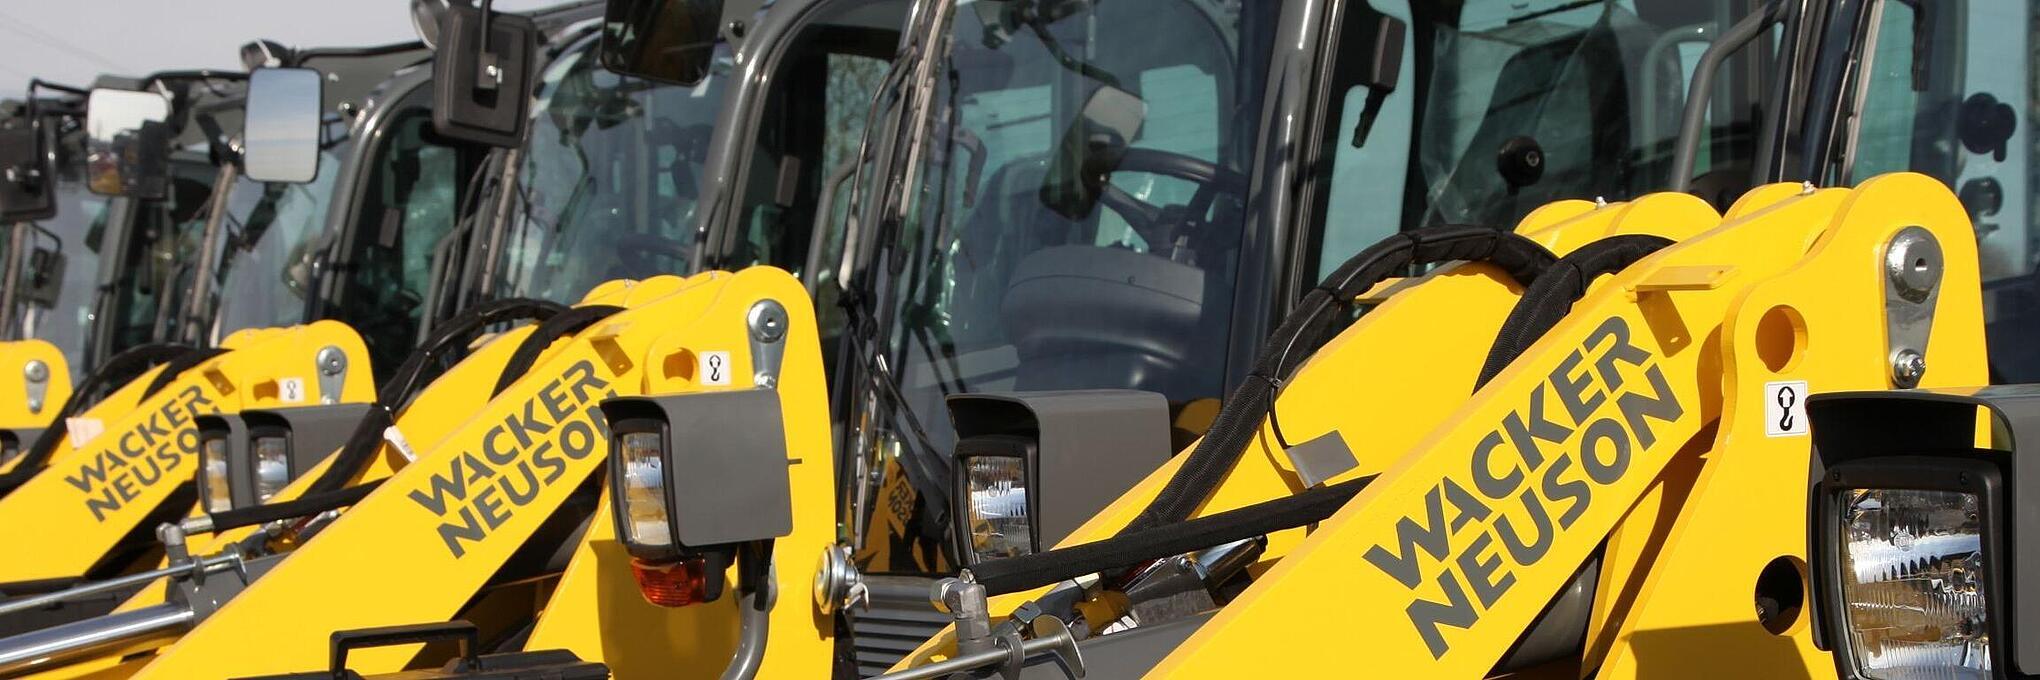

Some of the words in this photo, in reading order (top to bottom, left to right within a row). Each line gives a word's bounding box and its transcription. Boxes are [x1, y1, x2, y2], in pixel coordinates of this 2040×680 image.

[64, 385, 212, 493] WACKER
[86, 406, 220, 522] NEUSO
[407, 359, 609, 517] WACKER
[1361, 315, 1652, 590] WACKER
[1405, 362, 1684, 661] NEUSON
